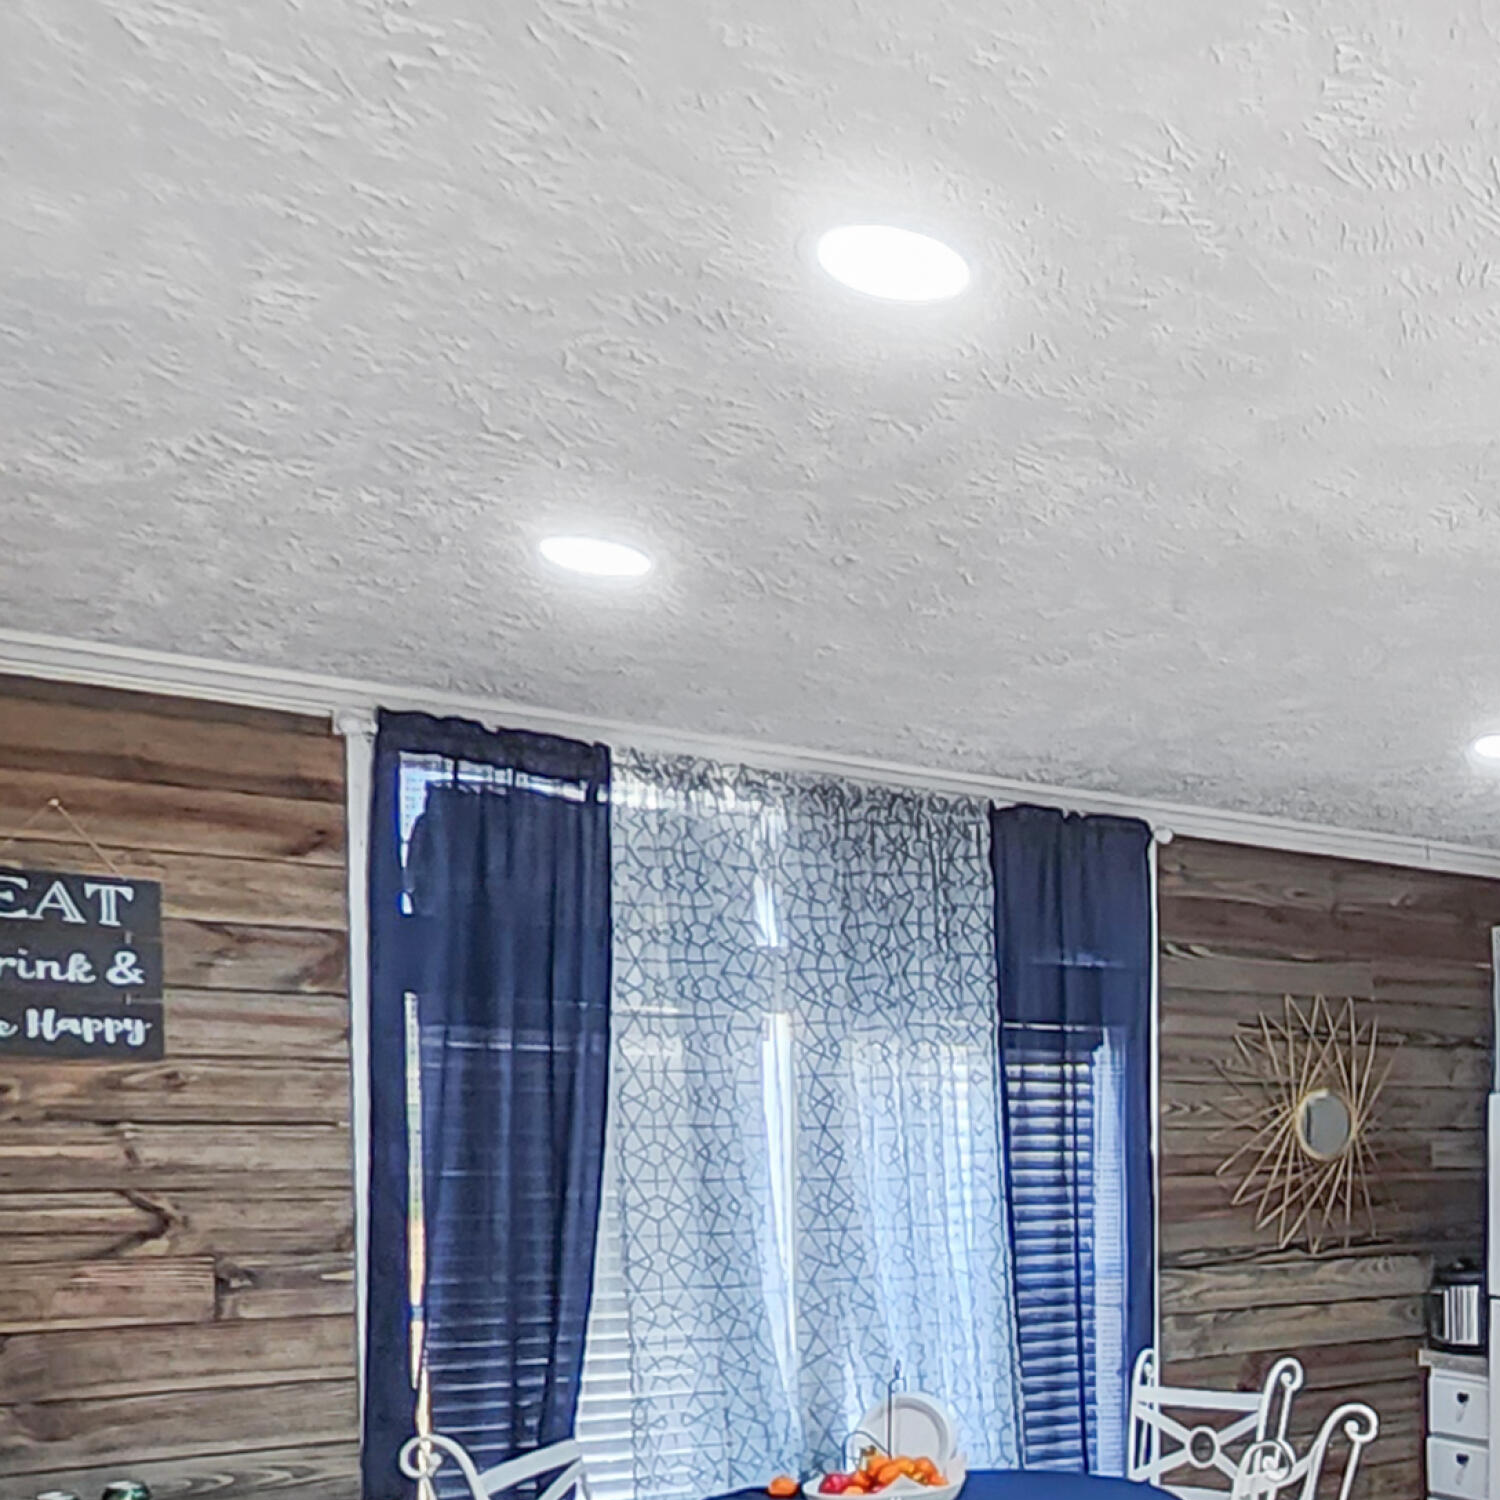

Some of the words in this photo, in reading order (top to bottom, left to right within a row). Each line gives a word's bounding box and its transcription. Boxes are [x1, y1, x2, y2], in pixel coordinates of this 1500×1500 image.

[0, 875, 135, 927] EAT
[0, 948, 96, 983] rink
[105, 950, 146, 986] &
[25, 1007, 153, 1046] Happy
